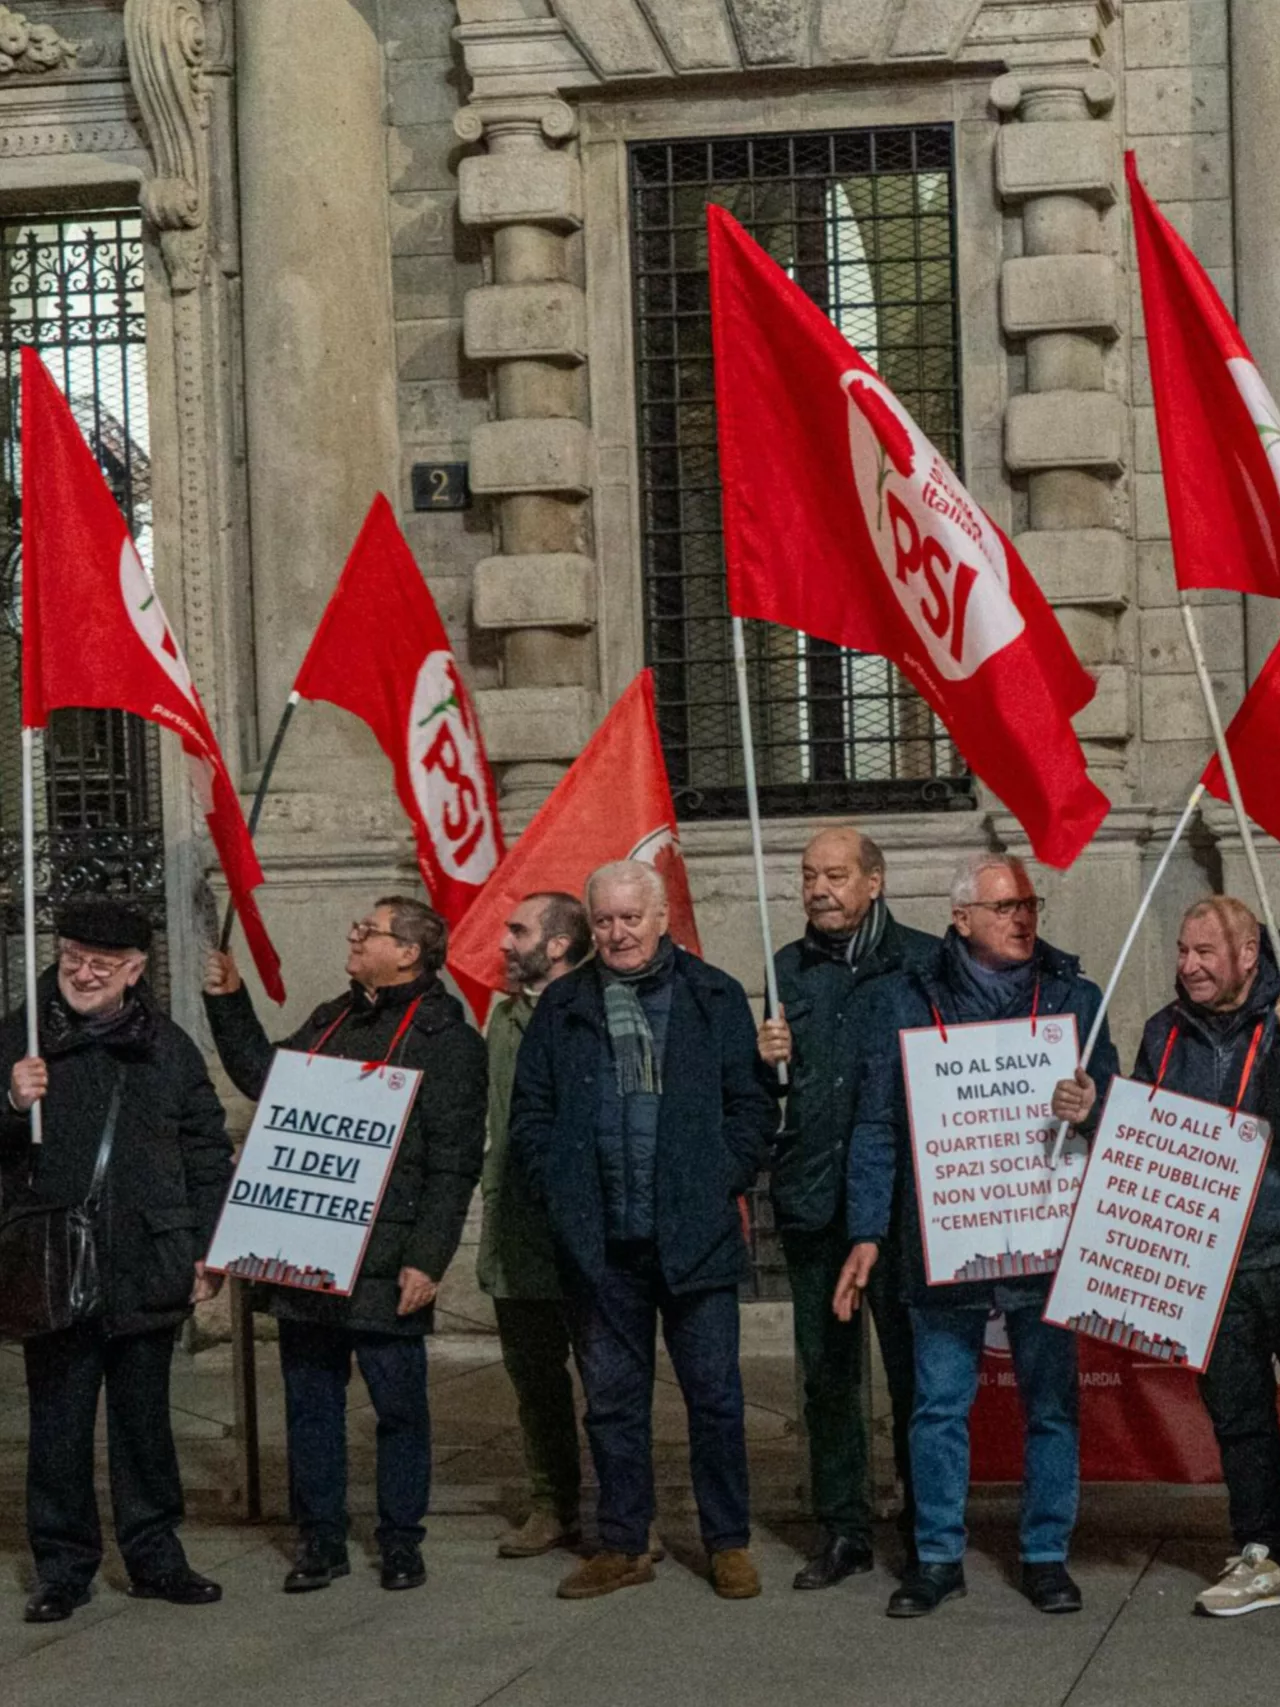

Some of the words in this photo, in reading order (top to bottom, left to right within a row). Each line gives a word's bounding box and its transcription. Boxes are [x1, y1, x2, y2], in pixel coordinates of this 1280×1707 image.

[430, 470, 449, 501] 2
[887, 490, 979, 664] PSI
[421, 719, 484, 868] PSI
[935, 1060, 963, 1077] NO
[968, 1058, 991, 1074] AL
[995, 1052, 1051, 1071] SALVA
[957, 1079, 1035, 1100] MILANO.
[269, 1104, 396, 1144] TANCREDI
[941, 1113, 947, 1127] I
[952, 1104, 1021, 1127] CORTILI
[1026, 1103, 1056, 1119] NE
[1150, 1107, 1177, 1128] NO
[1180, 1116, 1222, 1141] ALLE
[272, 1145, 295, 1168] TI
[301, 1151, 361, 1180] DEVI
[926, 1131, 1020, 1156] QUARTIERI
[1115, 1124, 1240, 1175] SPECULAZIONI.
[935, 1161, 985, 1180] SPAZI
[990, 1155, 1059, 1174] SOCIAL
[1064, 1152, 1073, 1166] E
[1101, 1147, 1143, 1171] AREE
[1146, 1161, 1241, 1201] PUBBLICHE
[232, 1180, 375, 1222] DIMETTERE
[933, 1188, 975, 1206] NON
[980, 1180, 1051, 1200] VOLUMI
[1058, 1177, 1081, 1192] DA
[1106, 1175, 1138, 1197] PER
[1140, 1184, 1160, 1204] LE
[1164, 1193, 1205, 1218] CASE
[1208, 1207, 1220, 1223] A
[1096, 1199, 1202, 1245] LAVORATORI
[1206, 1233, 1218, 1249] E
[1105, 1229, 1191, 1268] STUDENTI.
[1079, 1247, 1160, 1285] TANCREDI
[1164, 1273, 1208, 1300] DEVE
[1086, 1277, 1185, 1320] DIMETTERSI
